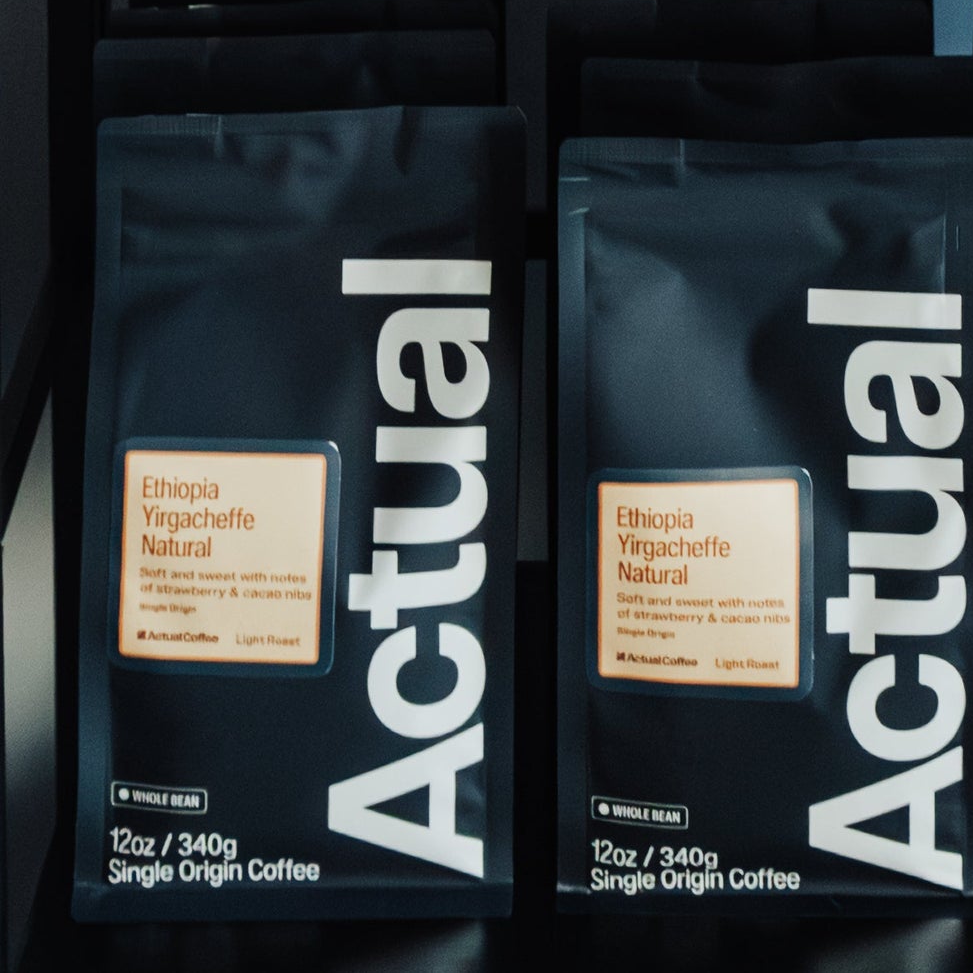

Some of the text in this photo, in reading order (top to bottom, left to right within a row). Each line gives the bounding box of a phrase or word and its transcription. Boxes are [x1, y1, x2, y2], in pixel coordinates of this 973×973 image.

[142, 475, 219, 505] Ethiopia
[142, 504, 255, 533] Yirgacheffe
[616, 505, 693, 534] Ethiopia
[141, 533, 211, 558] Natural
[617, 532, 730, 562] Yirgacheffe
[328, 259, 491, 878] Actual
[617, 561, 688, 585] Natural
[615, 591, 784, 608] Soft and sweet with notes
[807, 288, 966, 890] Actual
[616, 608, 630, 620] of
[632, 609, 704, 625] strawberry
[720, 615, 760, 624] cacao
[763, 614, 790, 623] nibs
[131, 789, 200, 808] WHOLE BEAN
[612, 804, 681, 824] WHOLE BEAN
[109, 826, 155, 857] 12oz
[177, 831, 237, 862] 340g
[591, 838, 637, 868] 12oz
[659, 845, 720, 873] 340g
[108, 857, 320, 888] Single Origin Coffee
[588, 867, 801, 894] Single Origin Coffee
